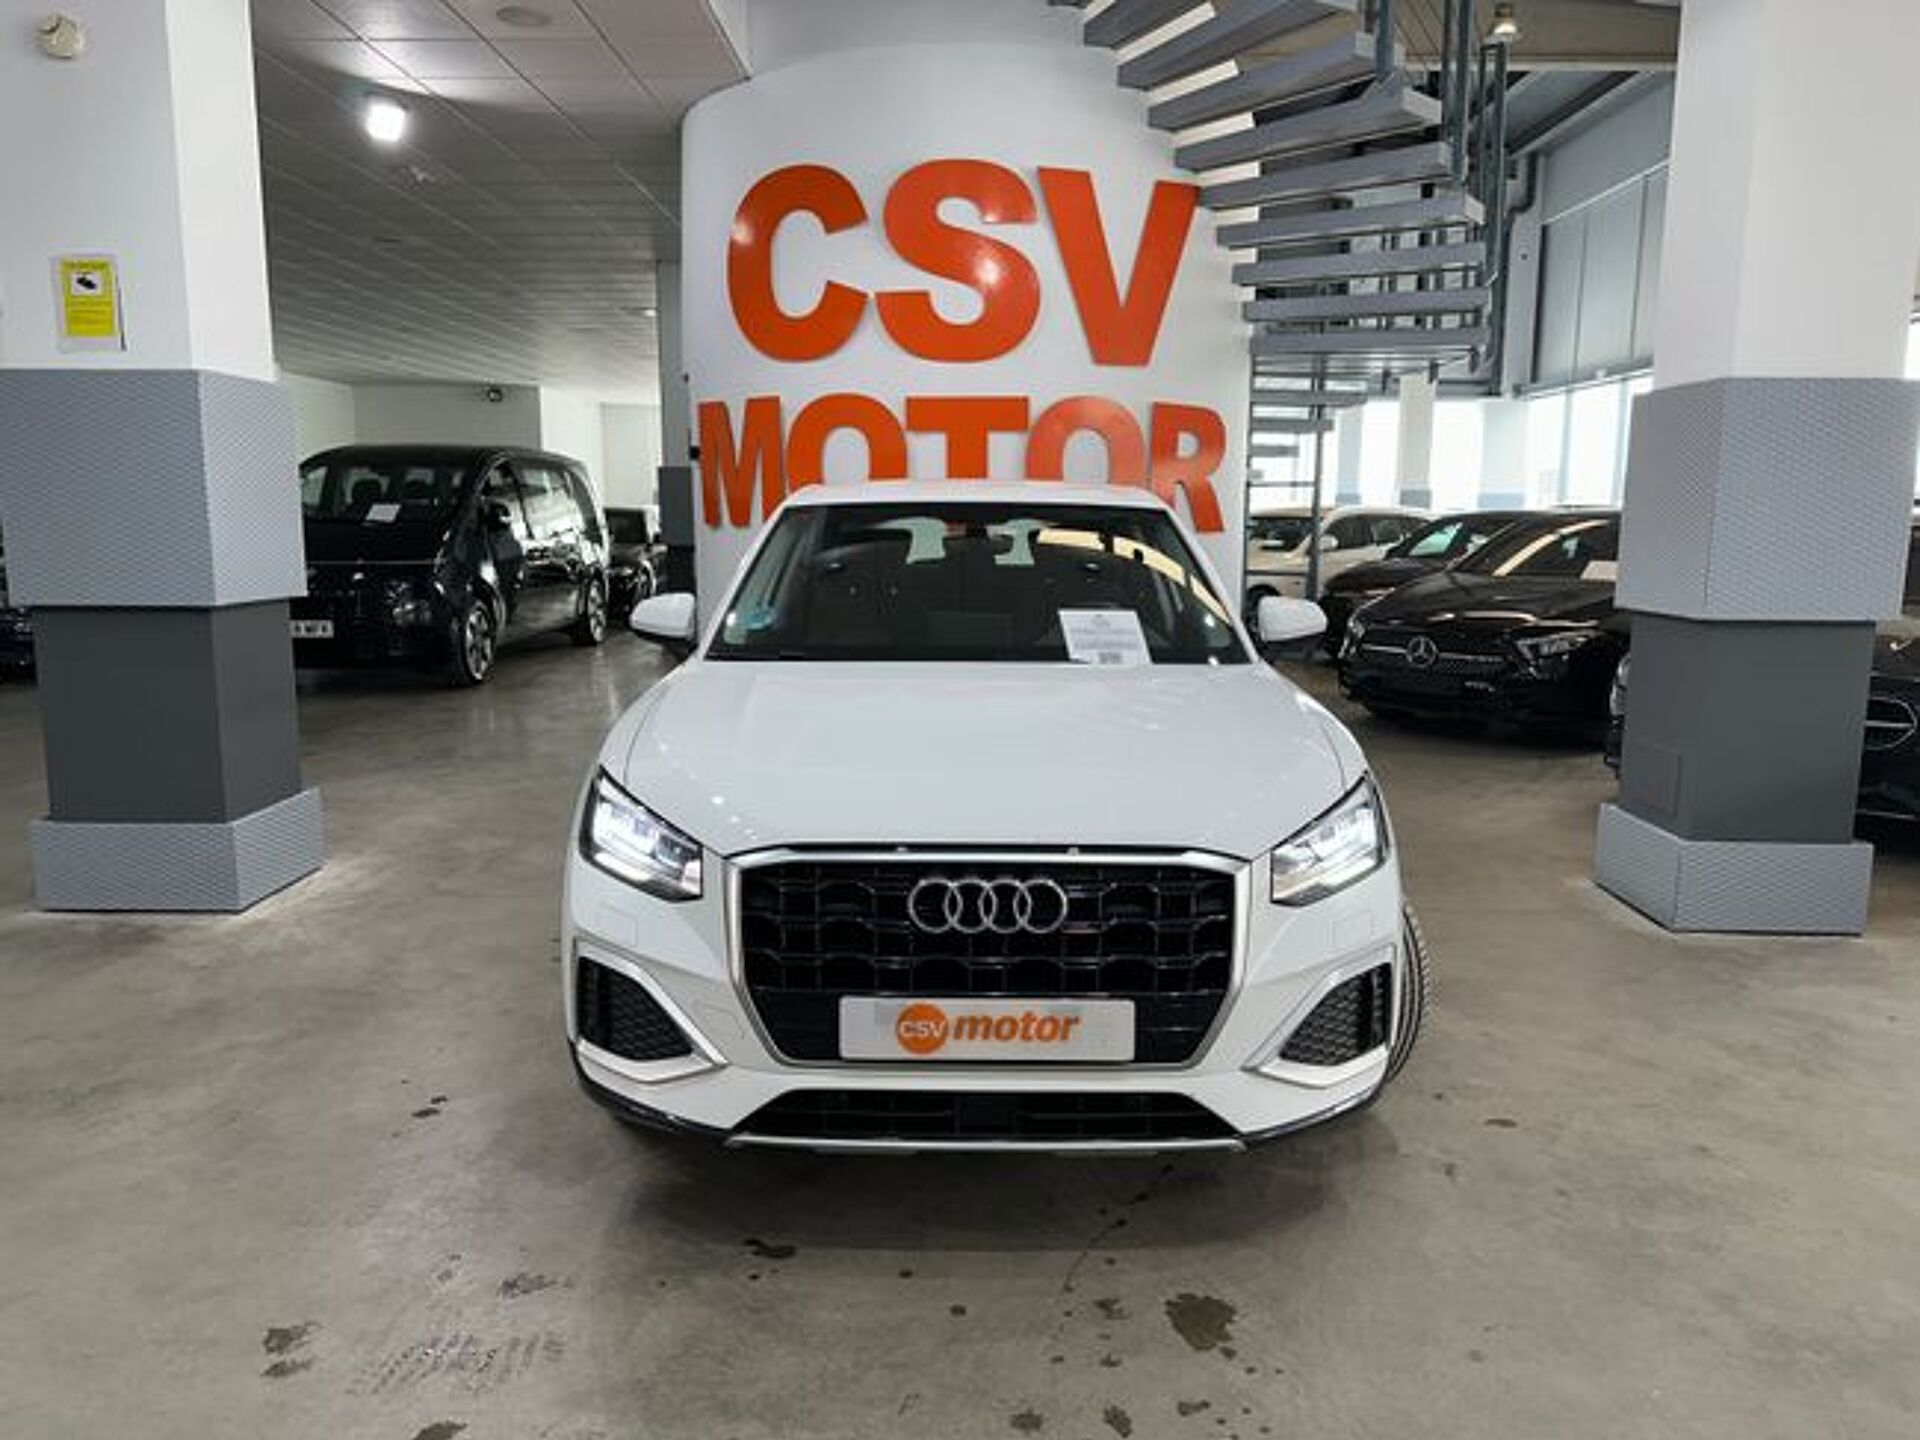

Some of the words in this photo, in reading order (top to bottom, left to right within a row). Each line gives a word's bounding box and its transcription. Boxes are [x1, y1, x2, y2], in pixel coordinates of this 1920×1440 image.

[728, 159, 1199, 365] CSV
[698, 393, 1227, 532] MOTOR
[953, 1009, 1081, 1042] motor
